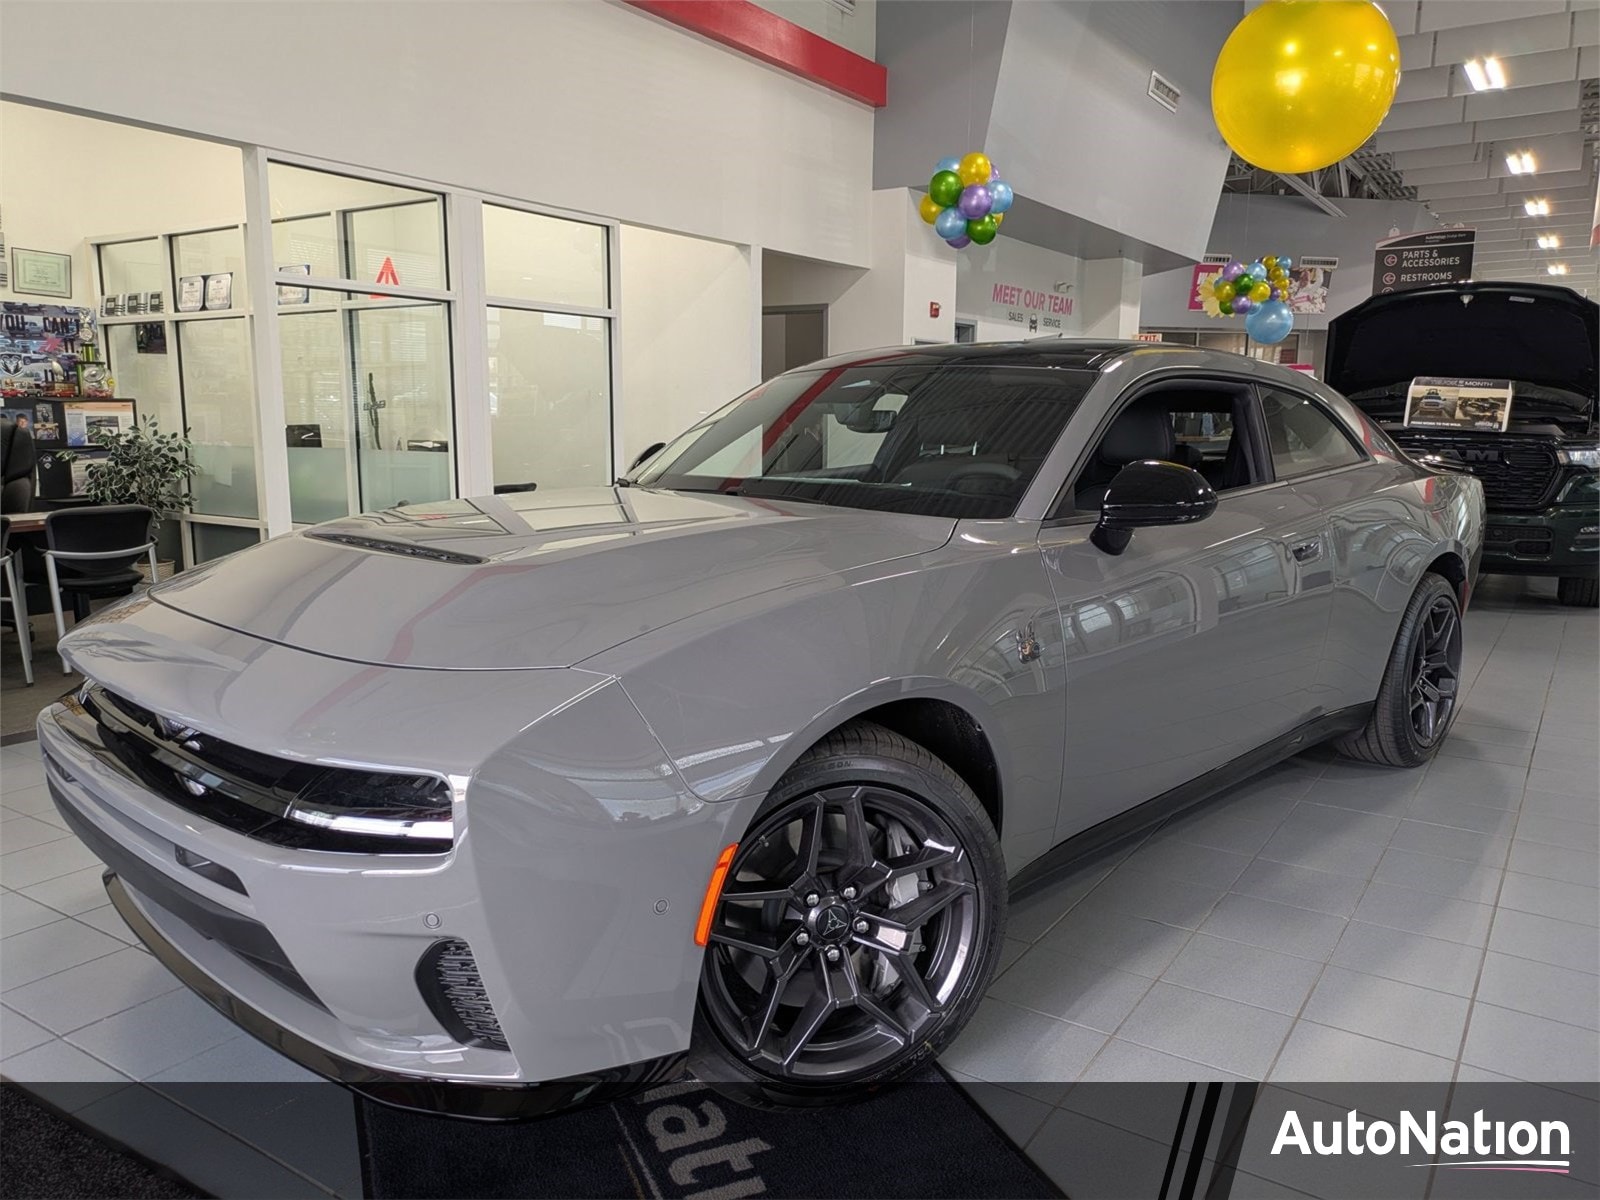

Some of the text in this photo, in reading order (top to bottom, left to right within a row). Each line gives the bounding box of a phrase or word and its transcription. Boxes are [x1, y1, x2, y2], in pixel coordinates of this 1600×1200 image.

[1402, 249, 1439, 259] PARTS &
[1402, 257, 1460, 268] ACCESSORIES
[1400, 272, 1453, 282] RESTROOMS
[992, 283, 1073, 316] MEET OUR TEAM
[0, 314, 26, 332] OU
[1008, 311, 1061, 328] SALES SERVICE
